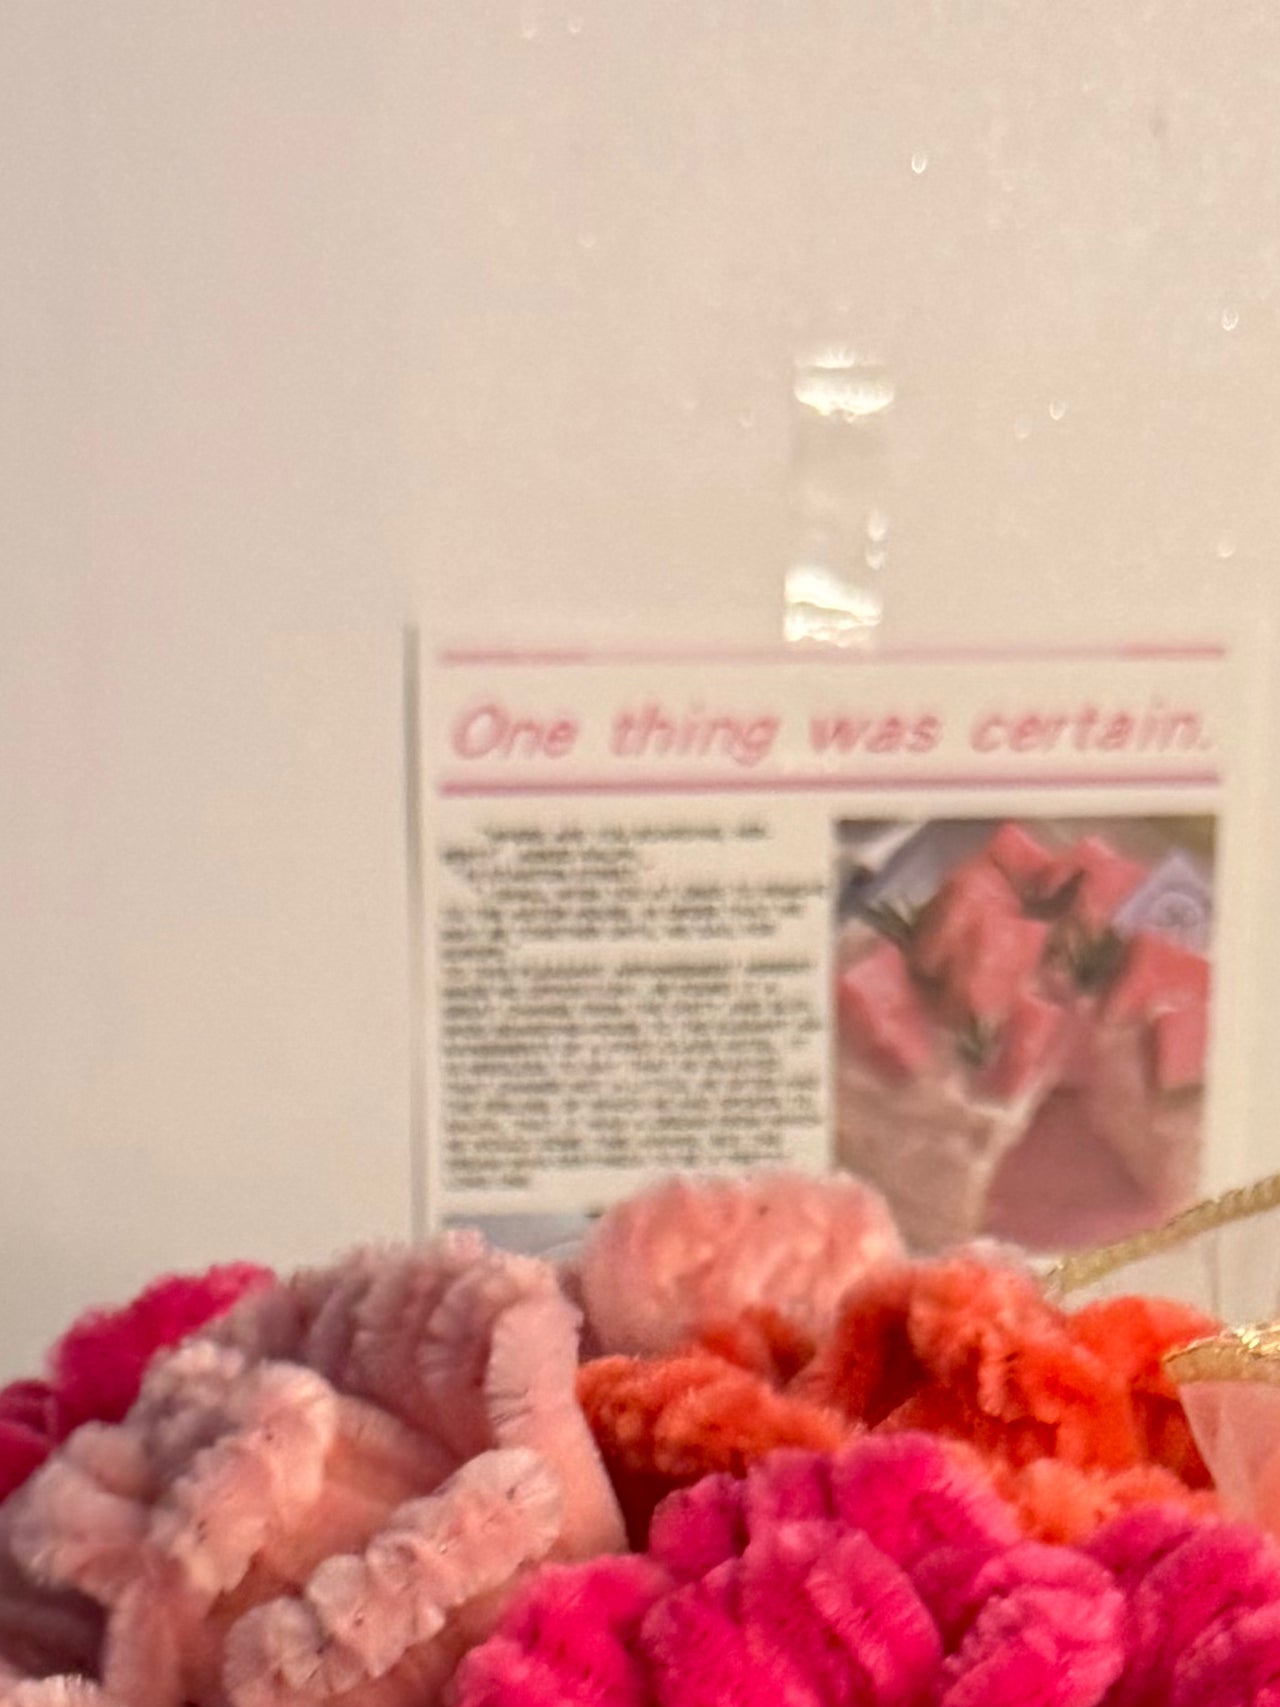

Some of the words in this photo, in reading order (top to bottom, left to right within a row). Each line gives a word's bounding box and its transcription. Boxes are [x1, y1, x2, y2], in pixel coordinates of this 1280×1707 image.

[452, 702, 580, 762] One
[611, 704, 781, 768] thing
[808, 709, 942, 756] was
[969, 701, 1217, 755] certain.
